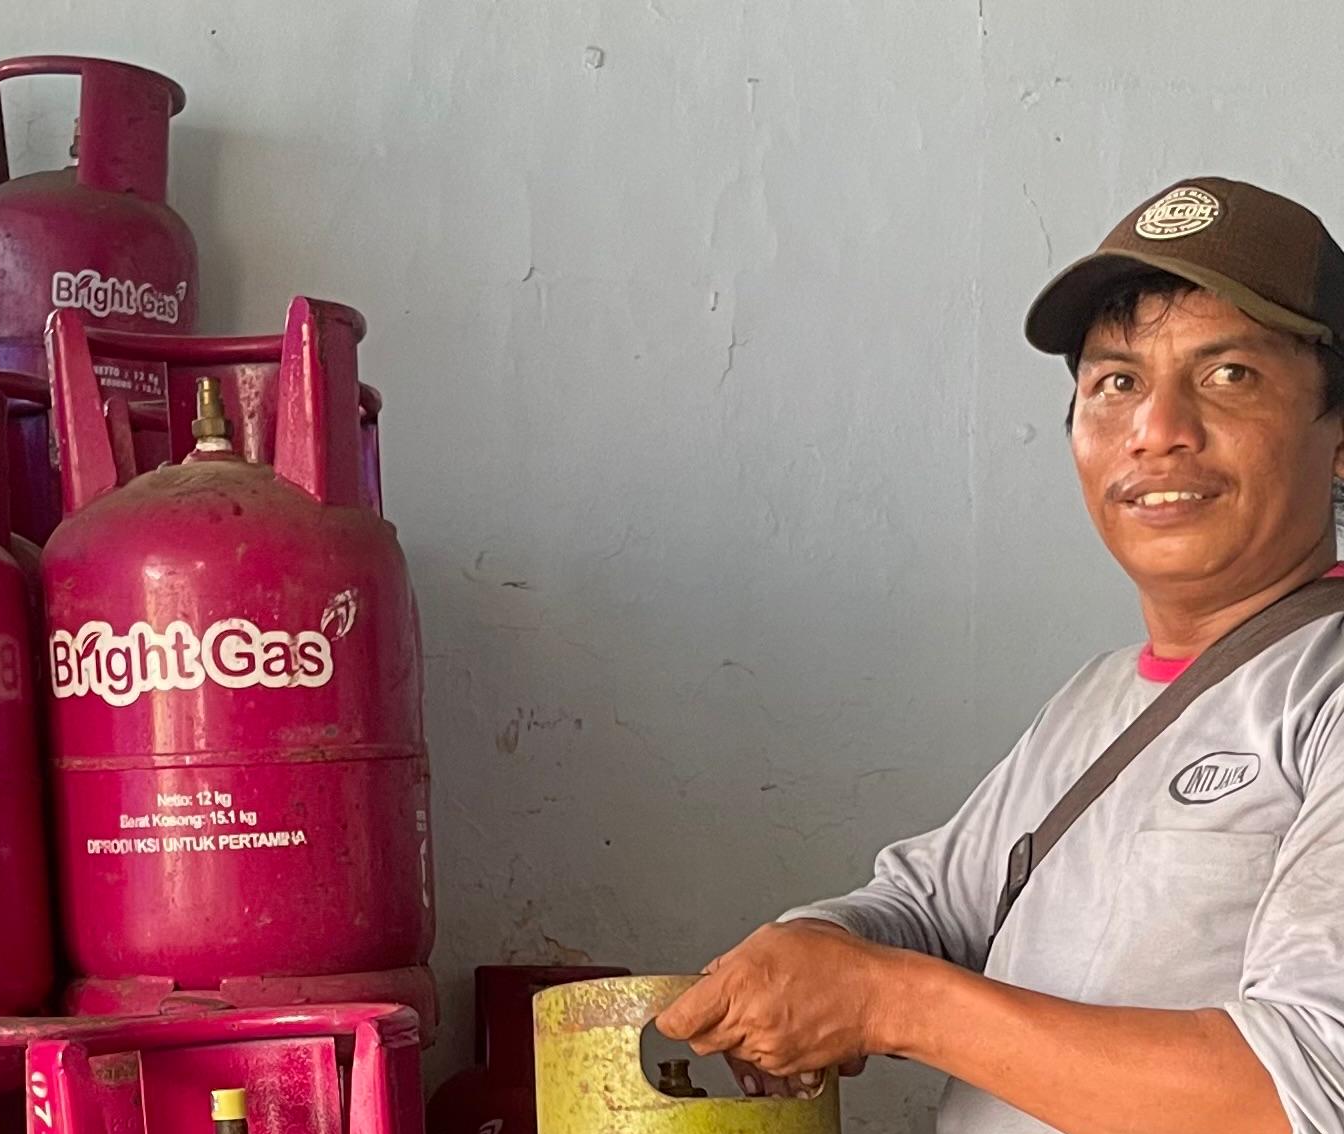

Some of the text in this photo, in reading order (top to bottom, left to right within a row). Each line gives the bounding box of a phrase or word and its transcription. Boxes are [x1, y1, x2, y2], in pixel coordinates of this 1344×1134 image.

[1144, 203, 1213, 221] VOLCOM
[55, 271, 177, 320] Bright Gas
[52, 627, 197, 698] Bright
[209, 626, 327, 679] Gas
[195, 791, 212, 806] 12
[214, 790, 232, 807] kg
[209, 810, 236, 825] 15.1
[239, 810, 257, 826] kg
[162, 835, 216, 852] UNTUK
[218, 830, 308, 850] PERTAMINA
